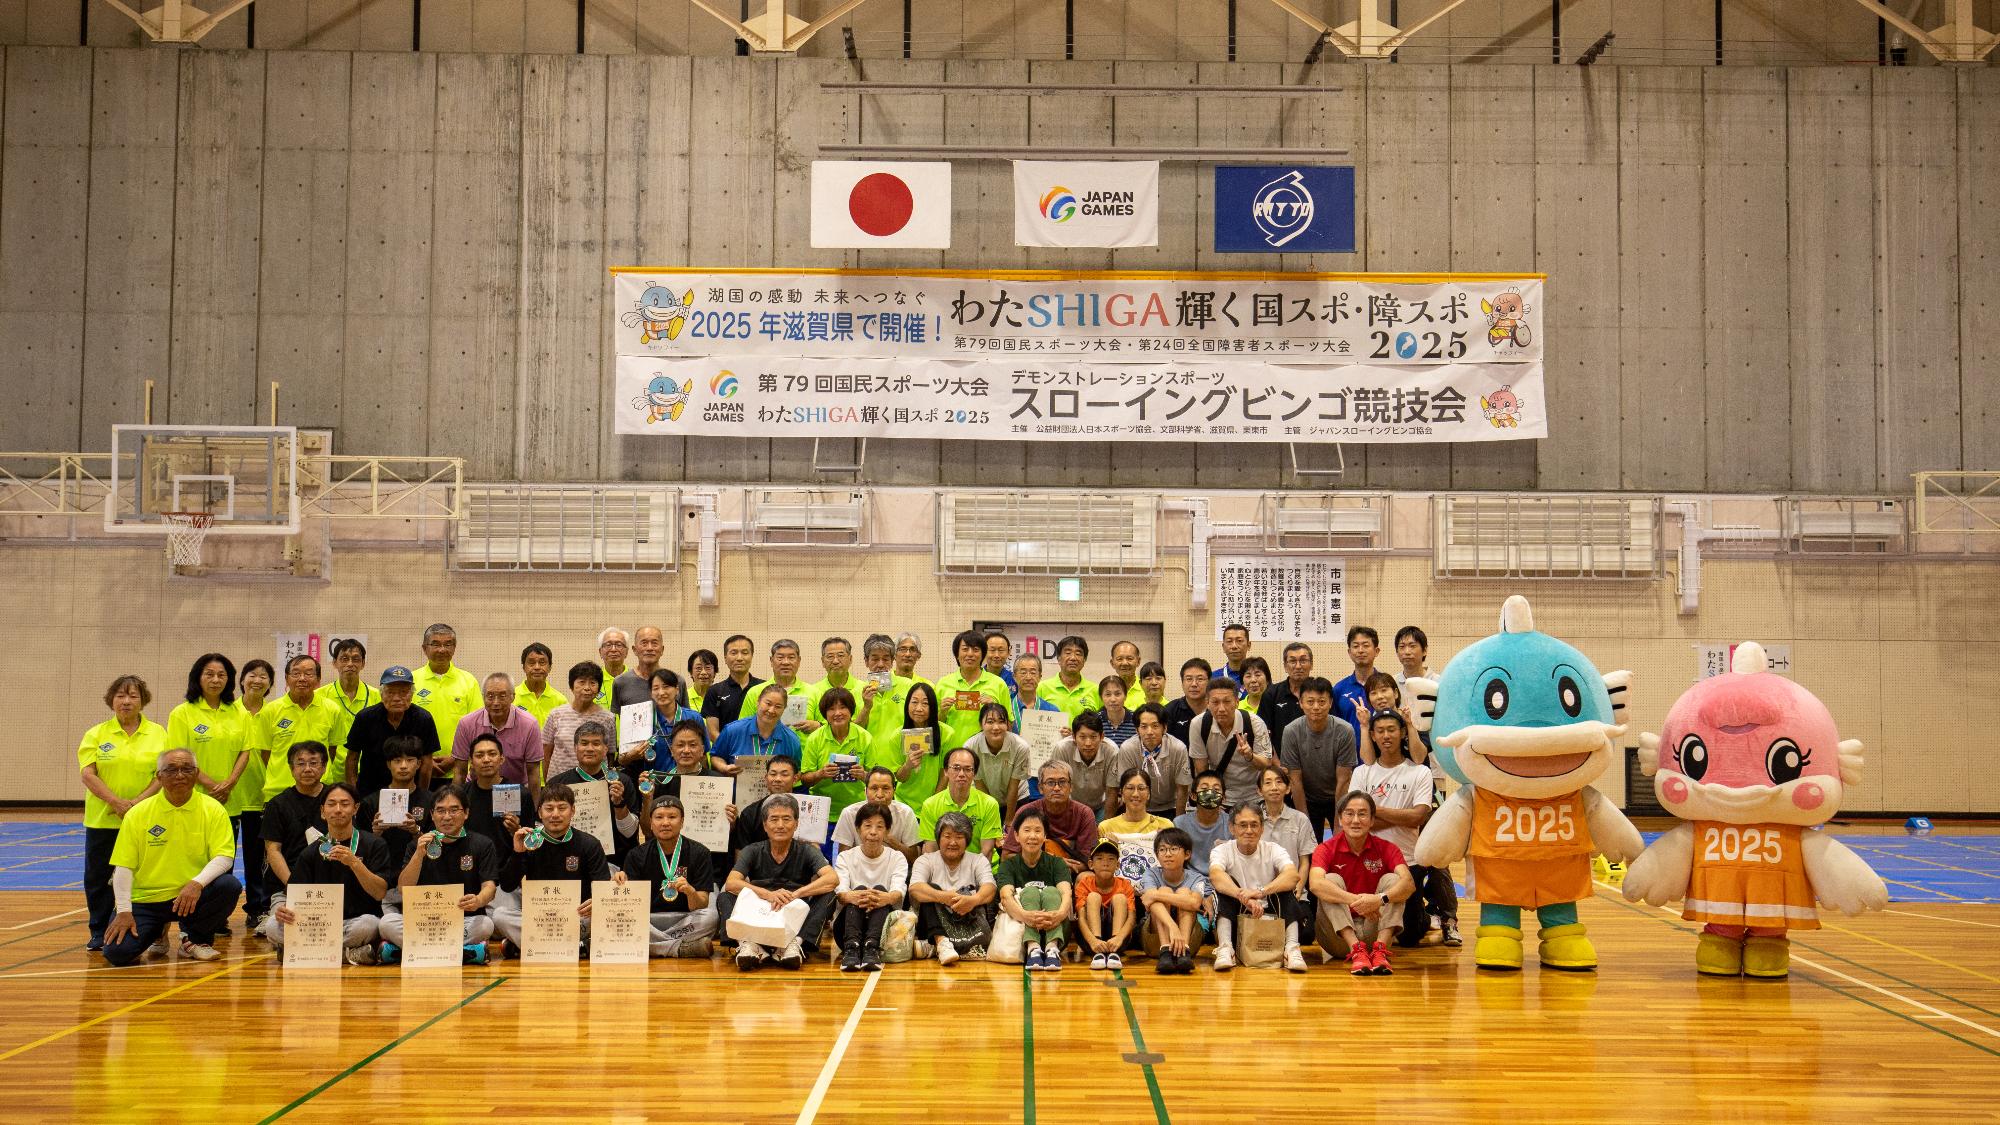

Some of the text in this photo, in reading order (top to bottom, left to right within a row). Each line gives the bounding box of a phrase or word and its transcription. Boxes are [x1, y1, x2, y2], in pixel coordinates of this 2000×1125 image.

[1082, 191, 1134, 203] JAPAN
[1082, 204, 1134, 216] GAMES
[708, 288, 926, 305] 湖国の感動 未来へつなぐ
[1011, 369, 1225, 386] デモンストレーションスポーツ
[704, 403, 744, 412] JAPAN
[1009, 385, 1466, 424] スローイングビンゴ競技会
[703, 413, 744, 422] GAMES
[1331, 568, 1342, 624] 市民憲章
[1494, 804, 1575, 842] 2025
[1704, 828, 1783, 864] 2025
